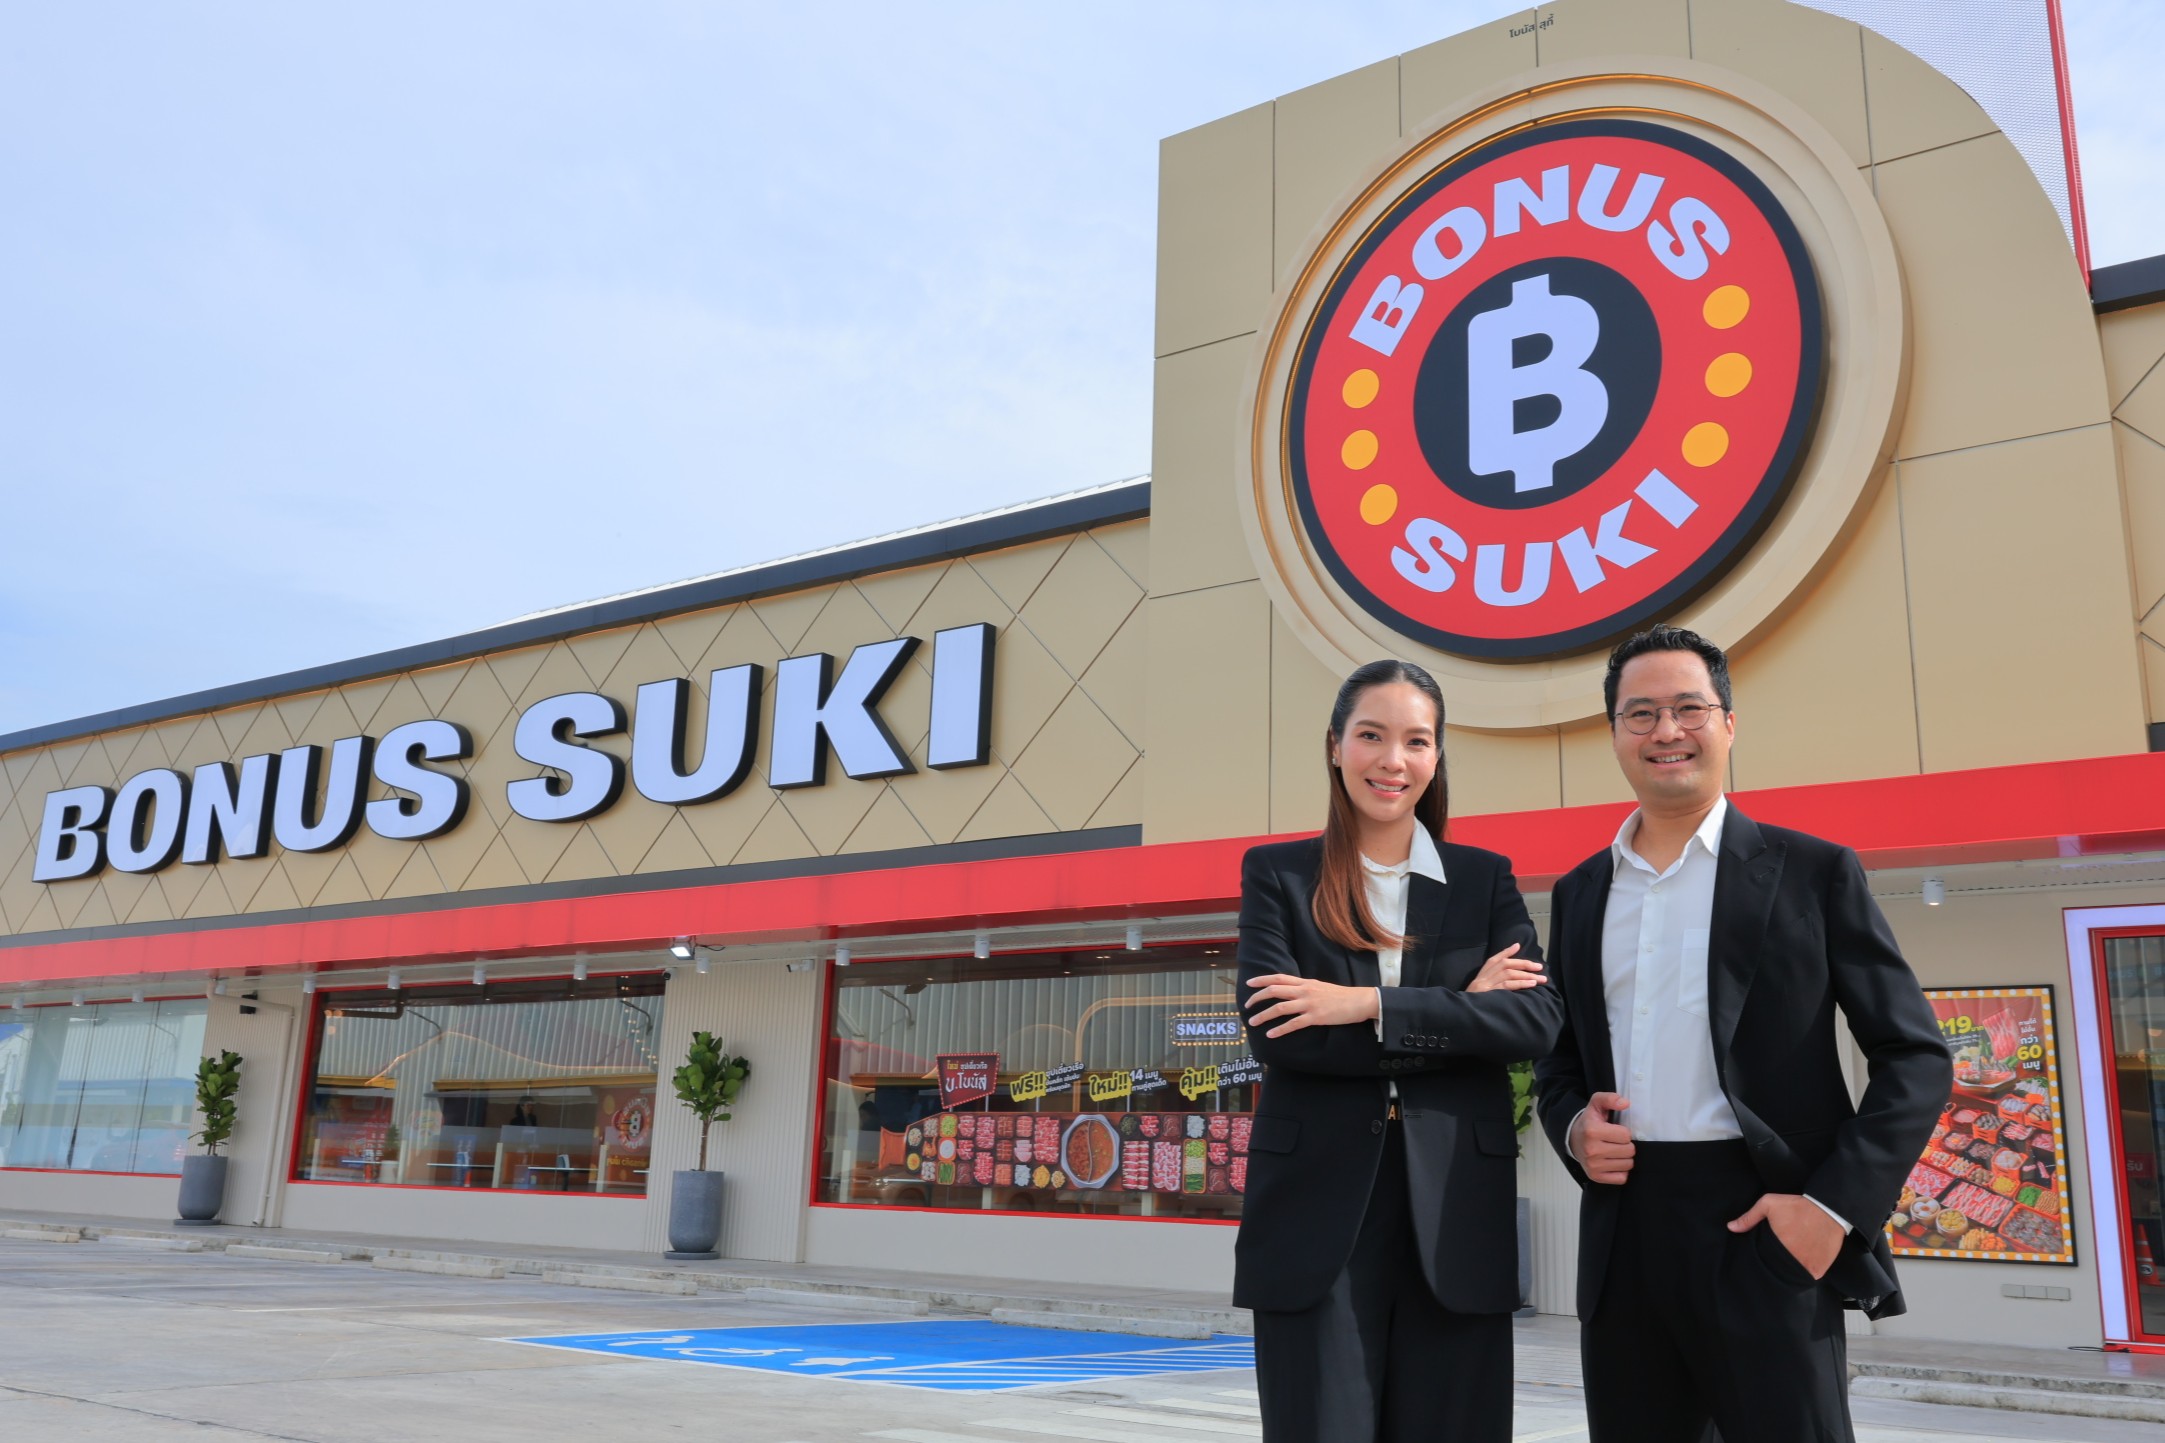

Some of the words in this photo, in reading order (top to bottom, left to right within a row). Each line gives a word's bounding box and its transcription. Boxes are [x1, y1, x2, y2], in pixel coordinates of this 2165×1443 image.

[1509, 23, 1536, 38] โบนัส
[1348, 163, 1730, 357] BONUS
[1390, 467, 1699, 607] SUKI
[32, 719, 474, 883] BONUS
[506, 621, 997, 825] SUKI
[1176, 1022, 1237, 1036] SNACKS
[2020, 1034, 2039, 1045] กว่า
[2017, 1044, 2043, 1061] 60
[2022, 1060, 2041, 1070] เมนู
[1090, 1072, 1128, 1095] ใหม่!!
[1129, 1068, 1144, 1082] 14
[1144, 1070, 1159, 1080] เมนู
[1181, 1067, 1216, 1095] คุ้ม!!
[1217, 1076, 1231, 1087] กว่า
[1232, 1072, 1247, 1083] 60
[1248, 1072, 1263, 1082] เมนู
[1012, 1073, 1044, 1096] ฟรี!!
